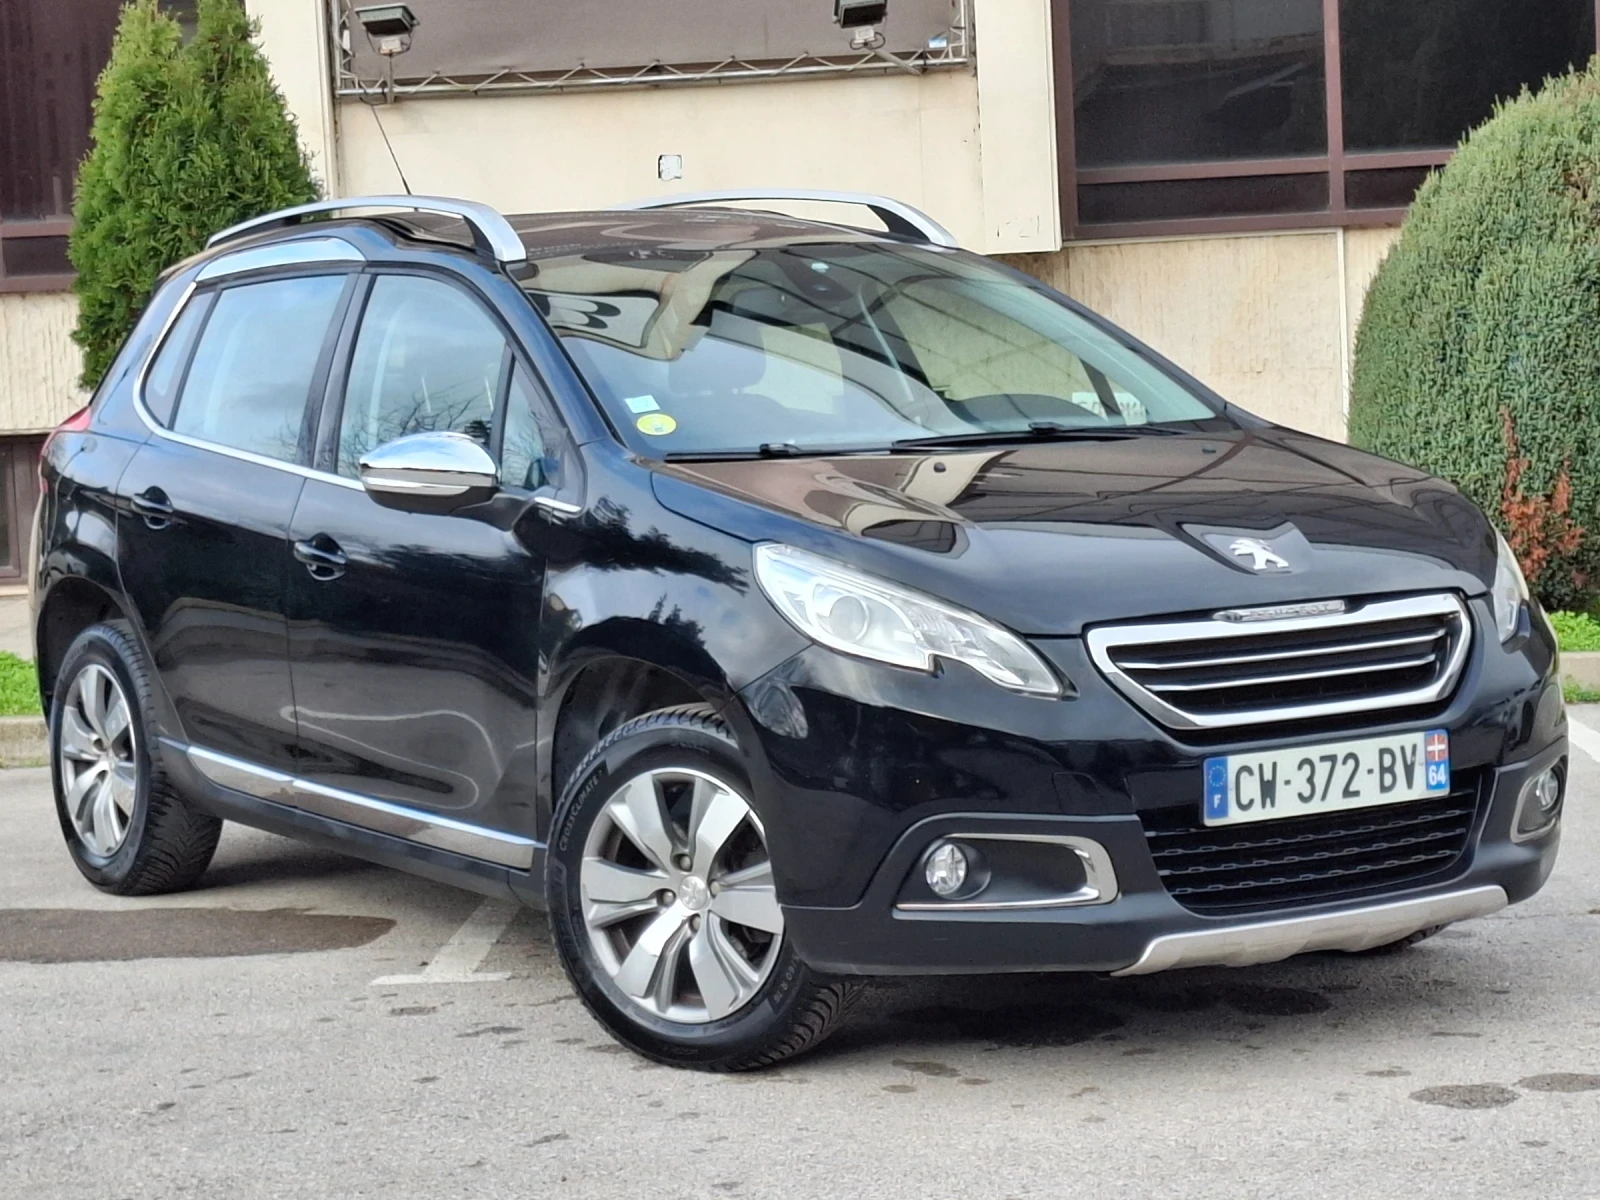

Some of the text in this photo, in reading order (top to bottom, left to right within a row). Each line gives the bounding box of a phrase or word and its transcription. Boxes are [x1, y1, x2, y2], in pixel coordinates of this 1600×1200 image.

[1234, 743, 1419, 812] CW-372-BV
[1428, 764, 1447, 786] 64
[1213, 794, 1222, 809] F
